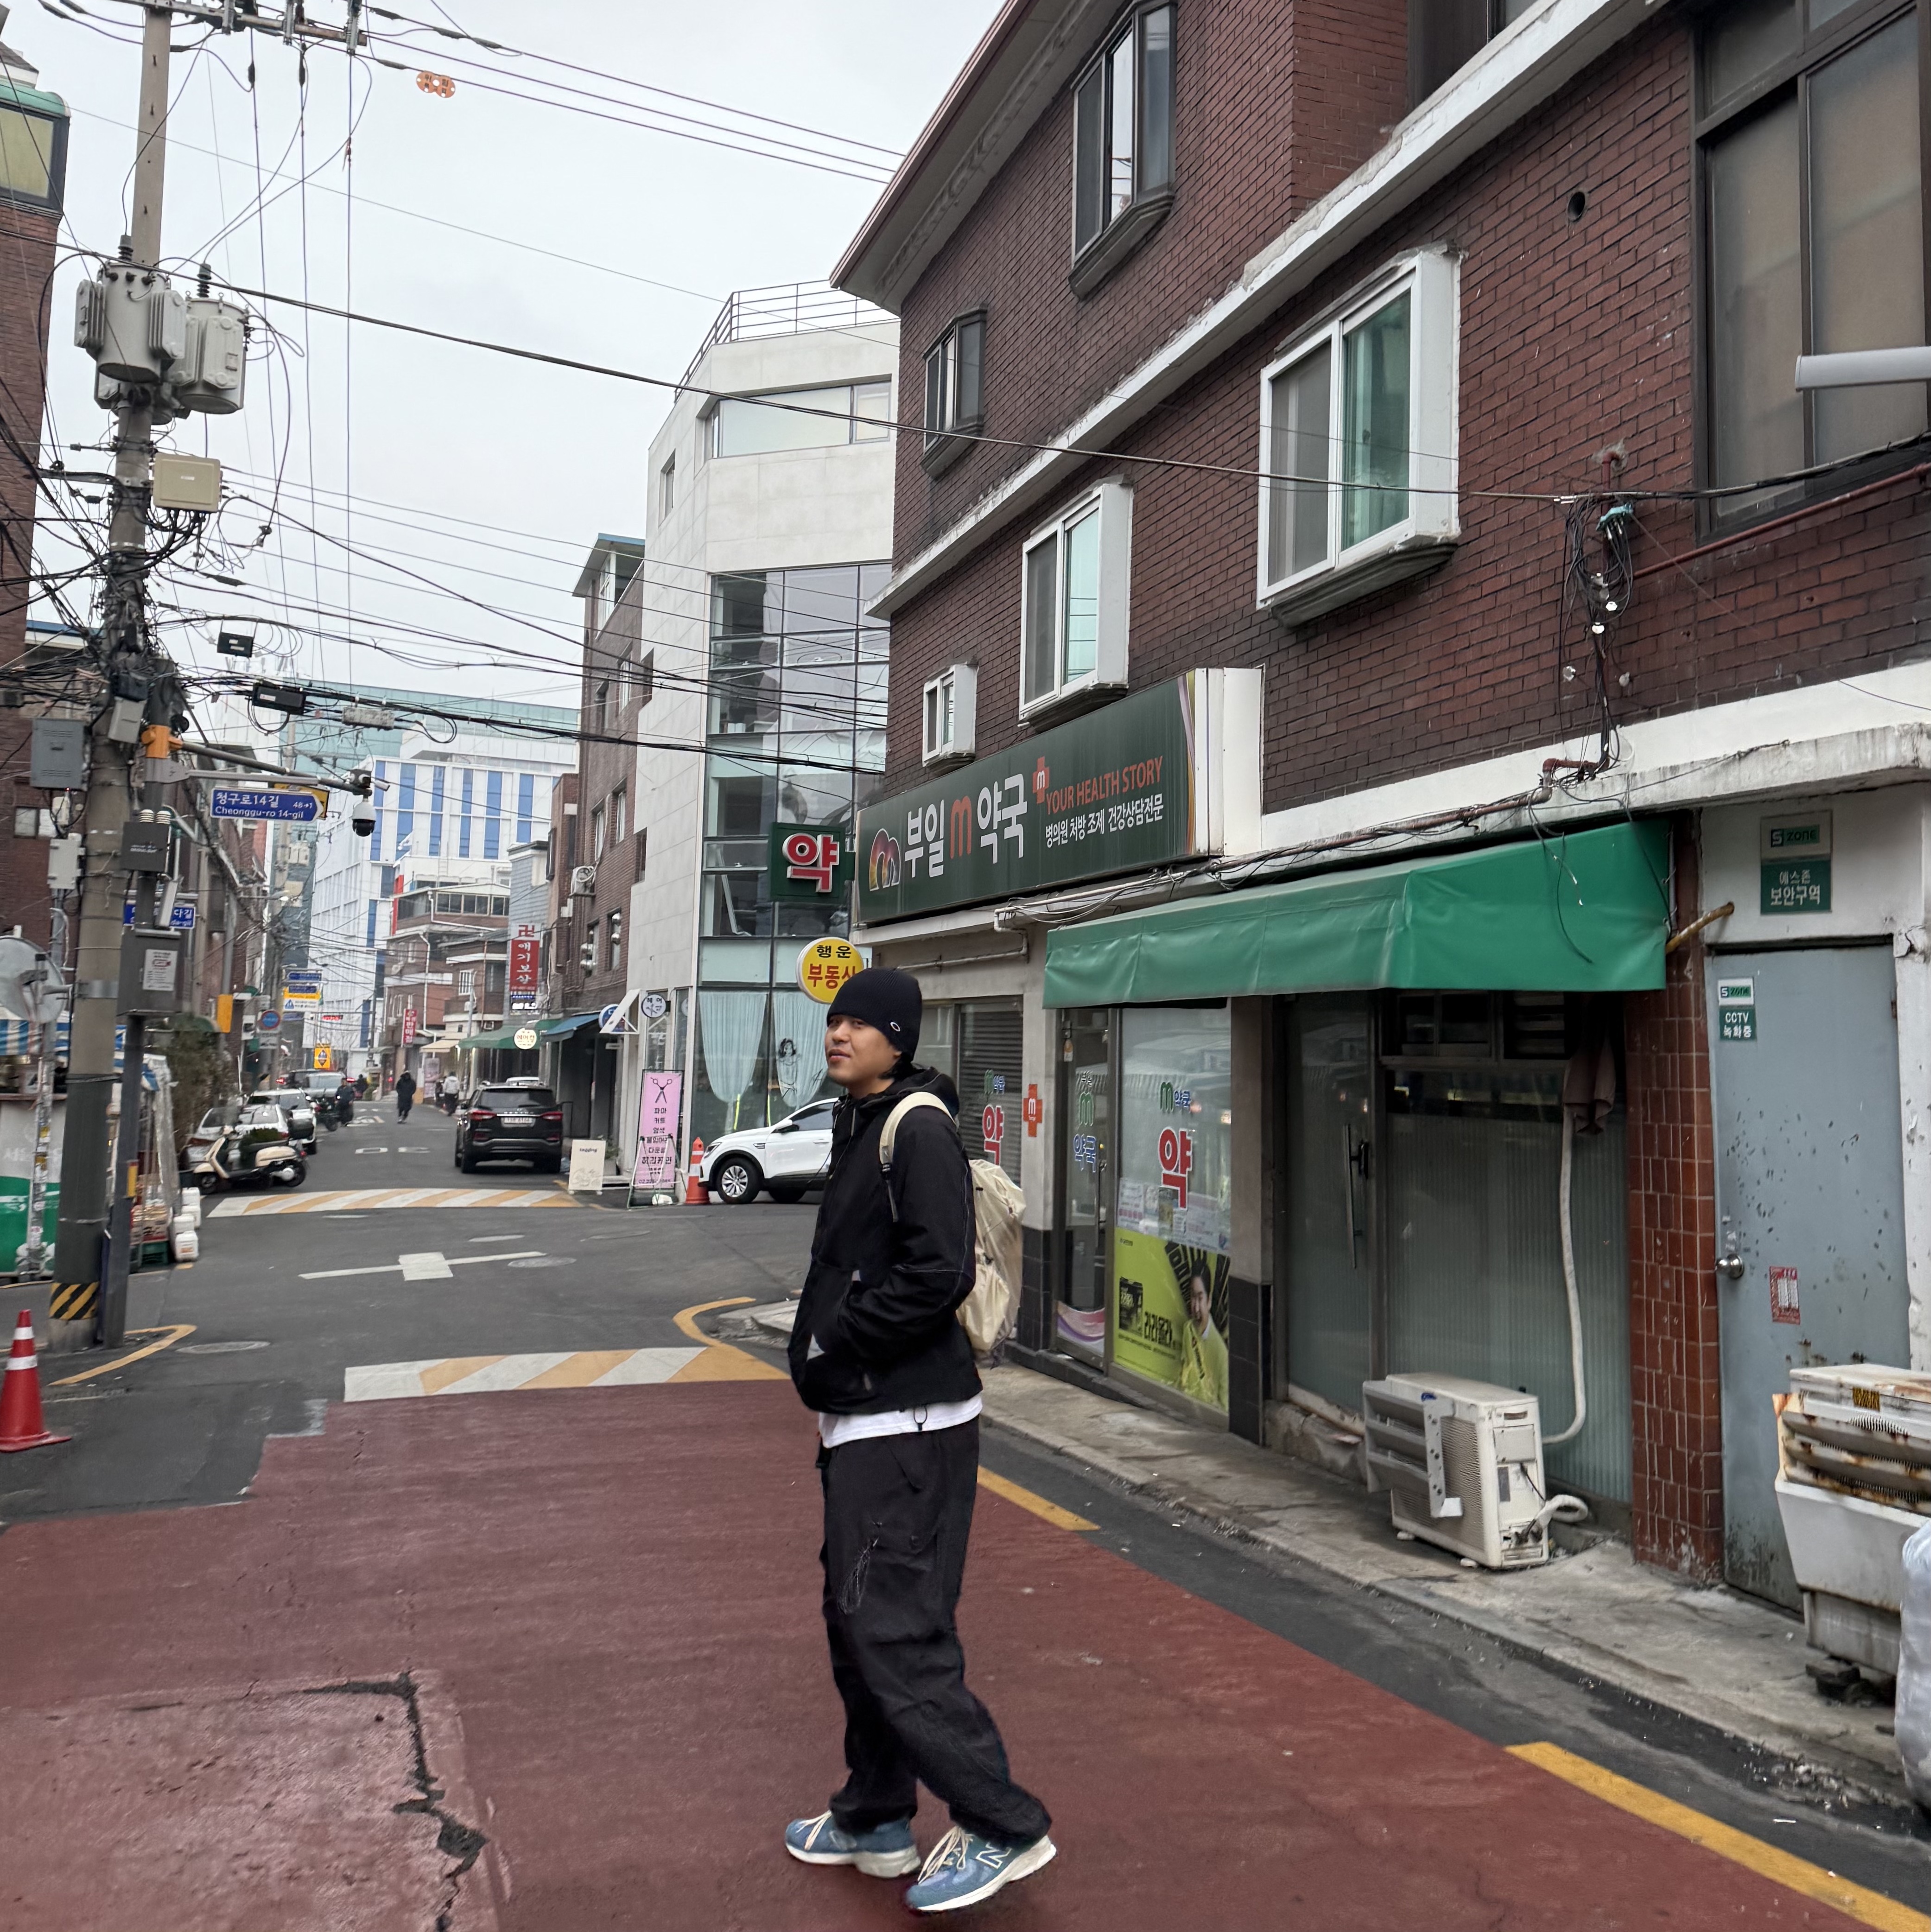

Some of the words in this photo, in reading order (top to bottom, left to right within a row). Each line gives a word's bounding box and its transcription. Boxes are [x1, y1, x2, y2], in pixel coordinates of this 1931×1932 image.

[216, 792, 279, 808] 청구로14길
[1046, 786, 1074, 815] YOUR
[1077, 769, 1119, 806] HEALTH
[1122, 756, 1163, 794] STORY
[215, 806, 276, 818] Cheonggu-ro
[279, 810, 304, 819] 14-gil
[905, 800, 944, 877] 부일
[950, 796, 972, 858] m
[978, 774, 1027, 864] 약국
[1046, 819, 1068, 848] 병의원
[1069, 814, 1086, 841] 처방
[1087, 808, 1104, 834] 조제
[1108, 793, 1163, 832] 건강상담전문
[782, 833, 839, 893] 약
[1779, 869, 1810, 885] 에스존
[1770, 884, 1820, 906] 보안구역
[817, 945, 851, 958] 행운
[1723, 1025, 1752, 1038] 녹화중
[1725, 1011, 1748, 1023] CCTV
[982, 1104, 1004, 1167] 약
[1073, 1134, 1096, 1173] 약국
[1158, 1126, 1193, 1210] 약
